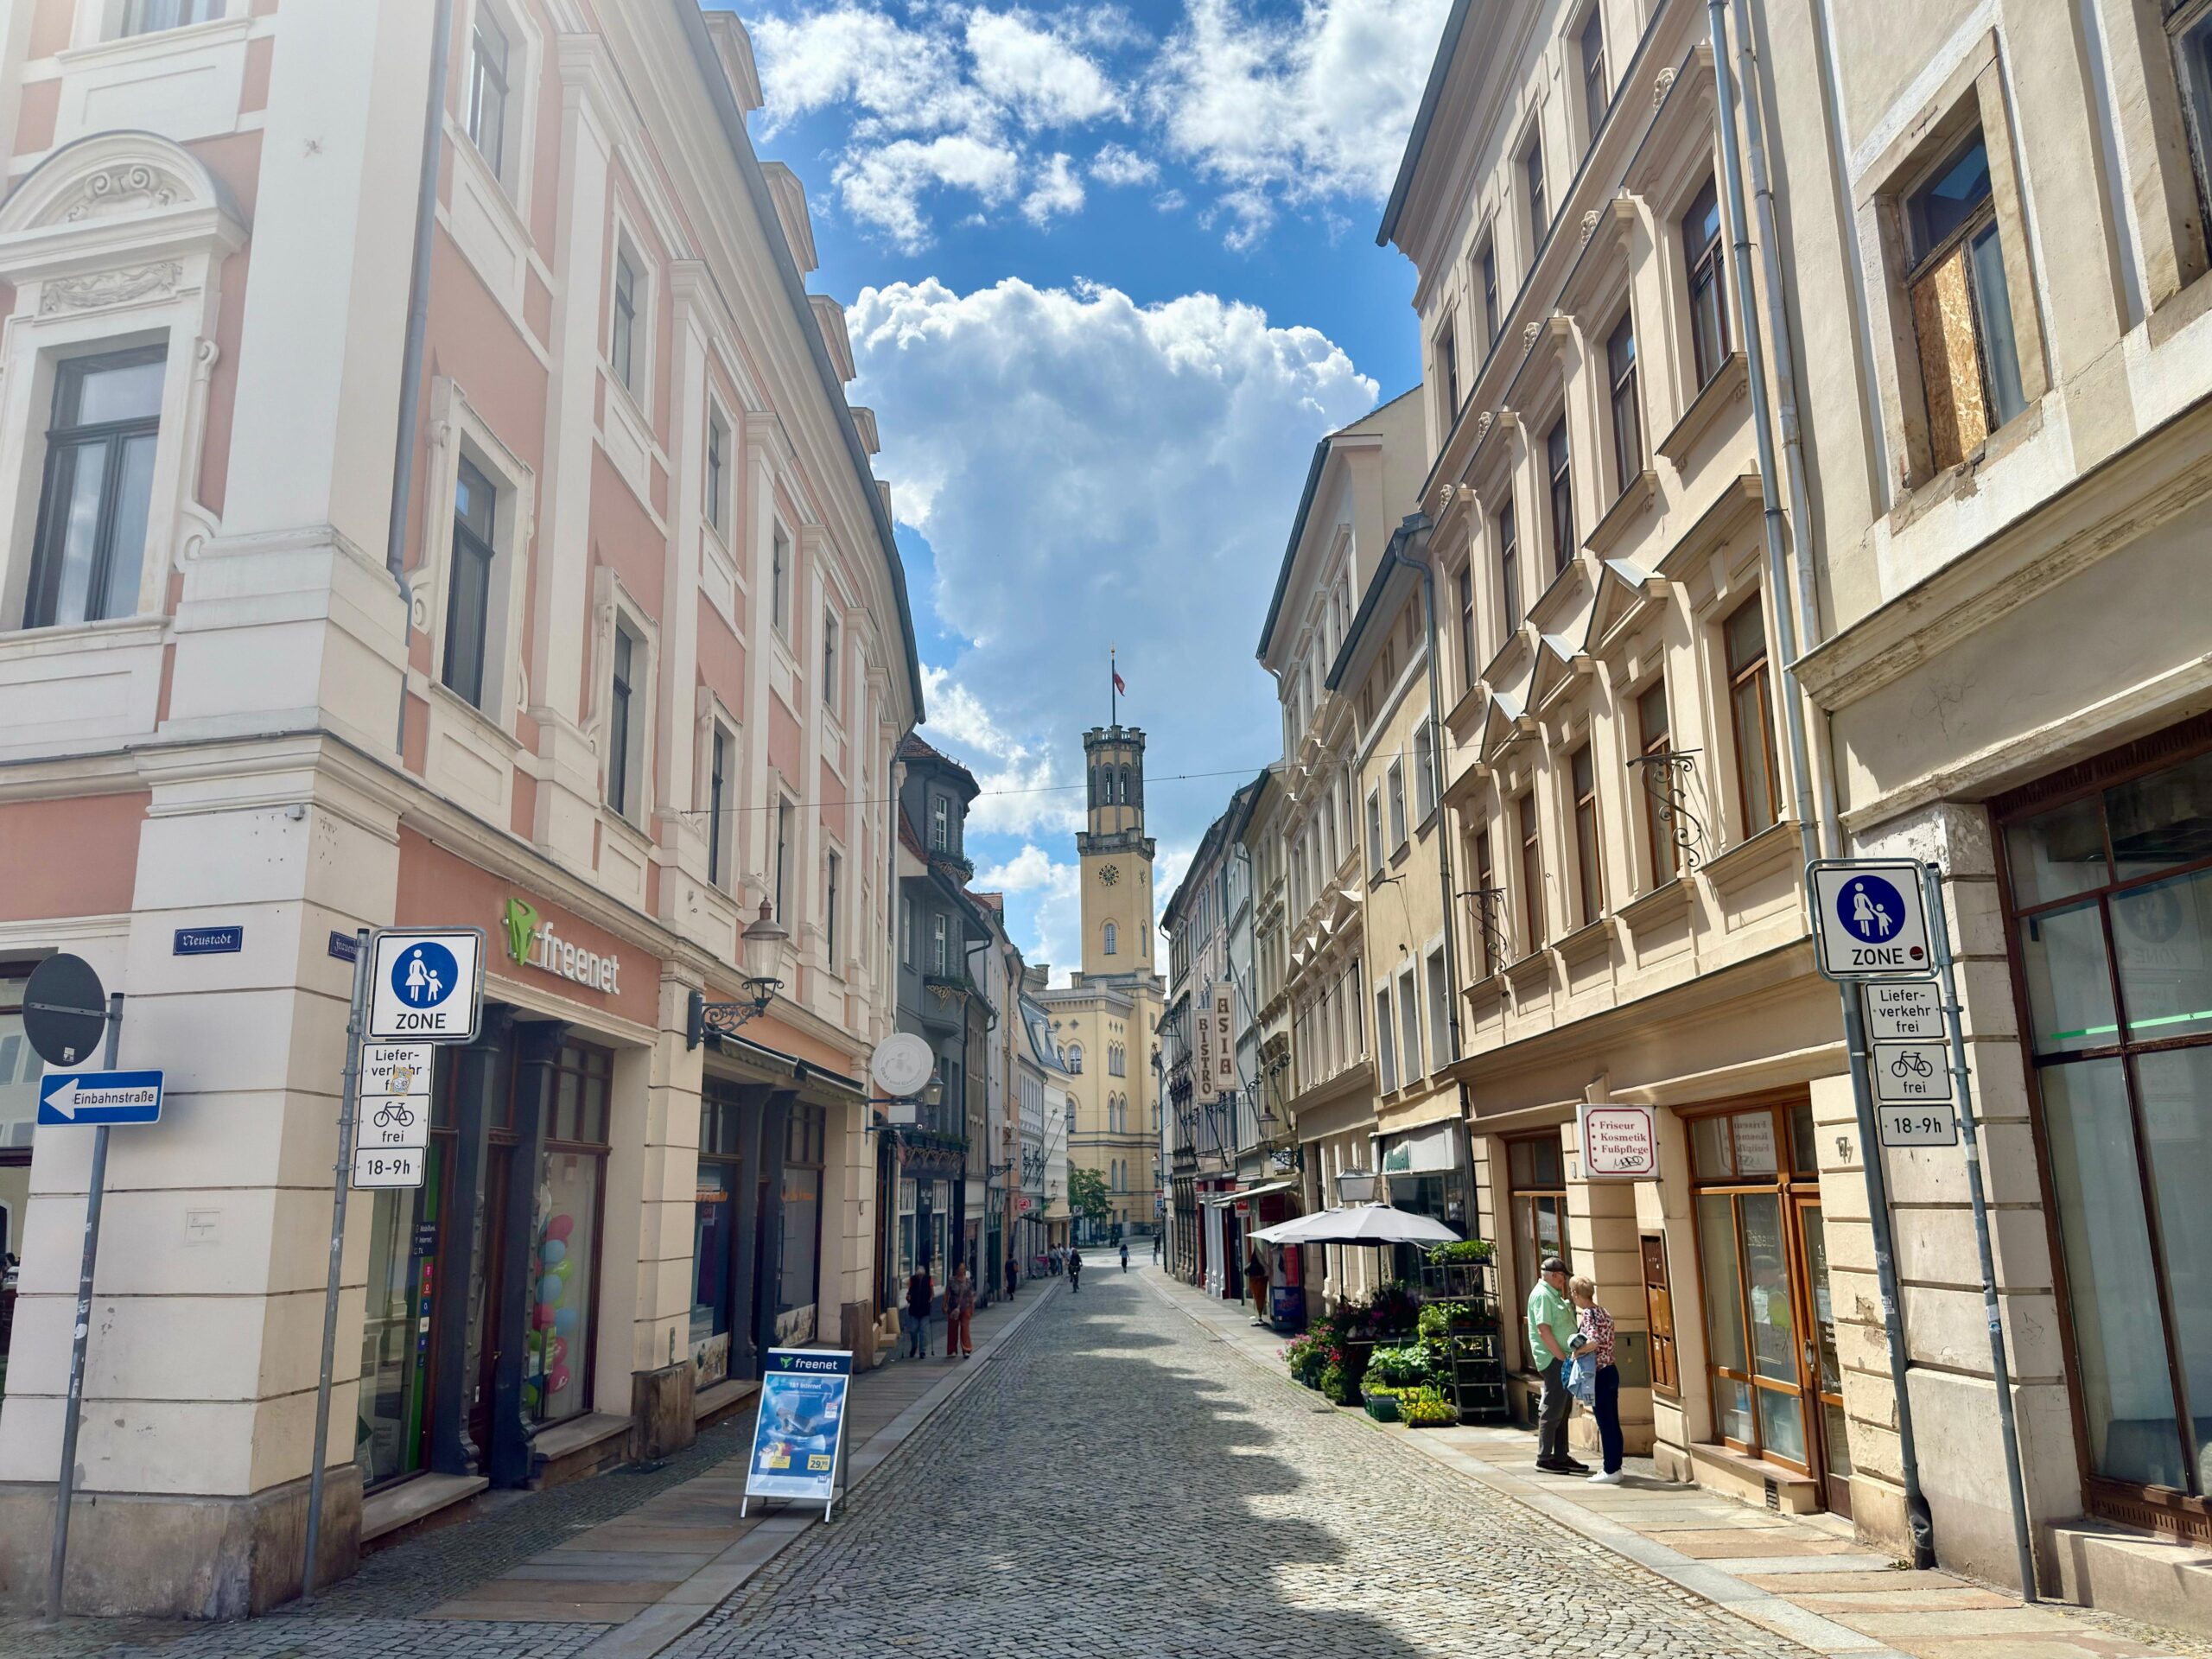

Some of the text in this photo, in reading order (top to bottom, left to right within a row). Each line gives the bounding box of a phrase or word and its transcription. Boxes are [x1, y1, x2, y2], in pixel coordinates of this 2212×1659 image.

[182, 933, 232, 946] Neustadt
[540, 921, 620, 995] freenet
[1852, 948, 1904, 966] ZONE
[1880, 989, 1926, 1002] Liefer-
[1879, 1005, 1931, 1017] verkehr
[395, 1013, 447, 1030] ZONE
[1896, 1020, 1919, 1033] frei
[1217, 998, 1232, 1075] ASIA
[375, 1049, 420, 1061] Liefer-
[1198, 1018, 1211, 1095] BISTRO
[372, 1064, 422, 1077] verhr
[1904, 1081, 1927, 1093] frei
[73, 1090, 154, 1104] Einbahnstraße
[1599, 1121, 1635, 1130] Friseur
[1894, 1116, 1942, 1134] 18-9h
[382, 1130, 404, 1142] frei
[1600, 1132, 1647, 1141] Kosmetik
[1601, 1144, 1649, 1155] Fußpflege
[367, 1159, 410, 1175] 18-9h
[795, 1358, 838, 1370] freenet
